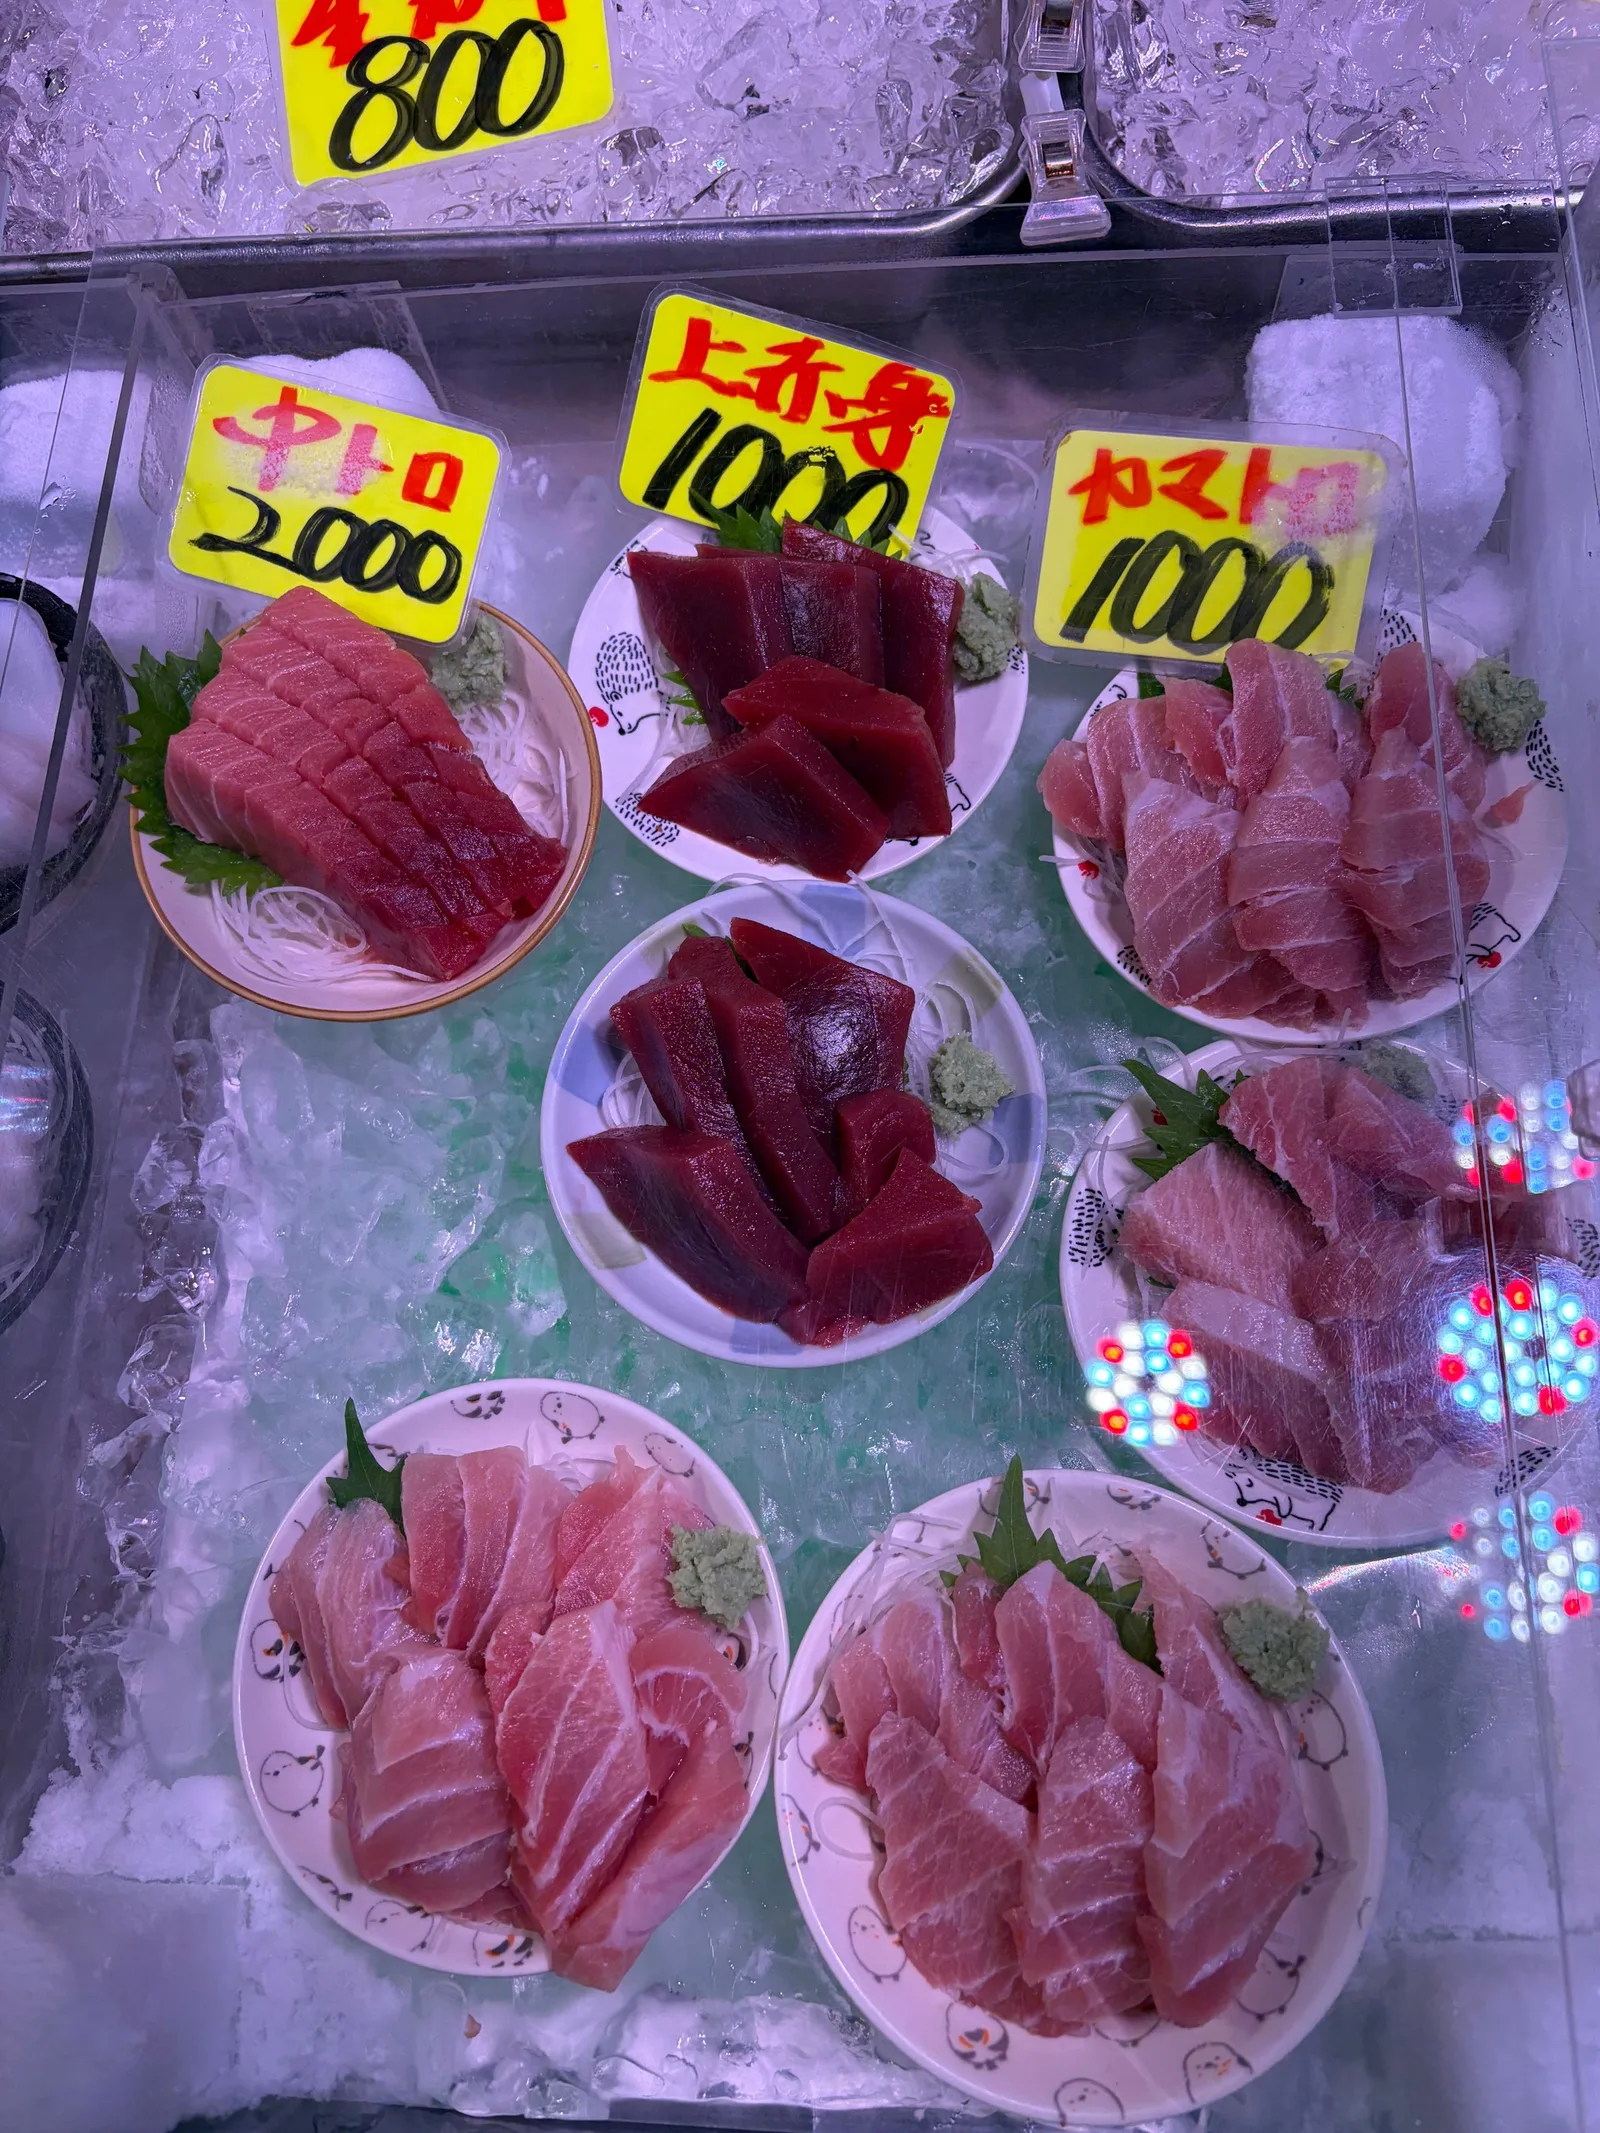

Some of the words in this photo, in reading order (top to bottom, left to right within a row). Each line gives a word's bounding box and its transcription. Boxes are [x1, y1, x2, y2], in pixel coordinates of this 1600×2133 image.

[329, 18, 565, 172] 800
[212, 386, 463, 512] 中トロ
[648, 317, 950, 473] 上赤身
[642, 407, 909, 544] 1000
[1067, 447, 1360, 538] カマトロ
[188, 486, 462, 604] 2000
[1059, 530, 1335, 656] 1000
